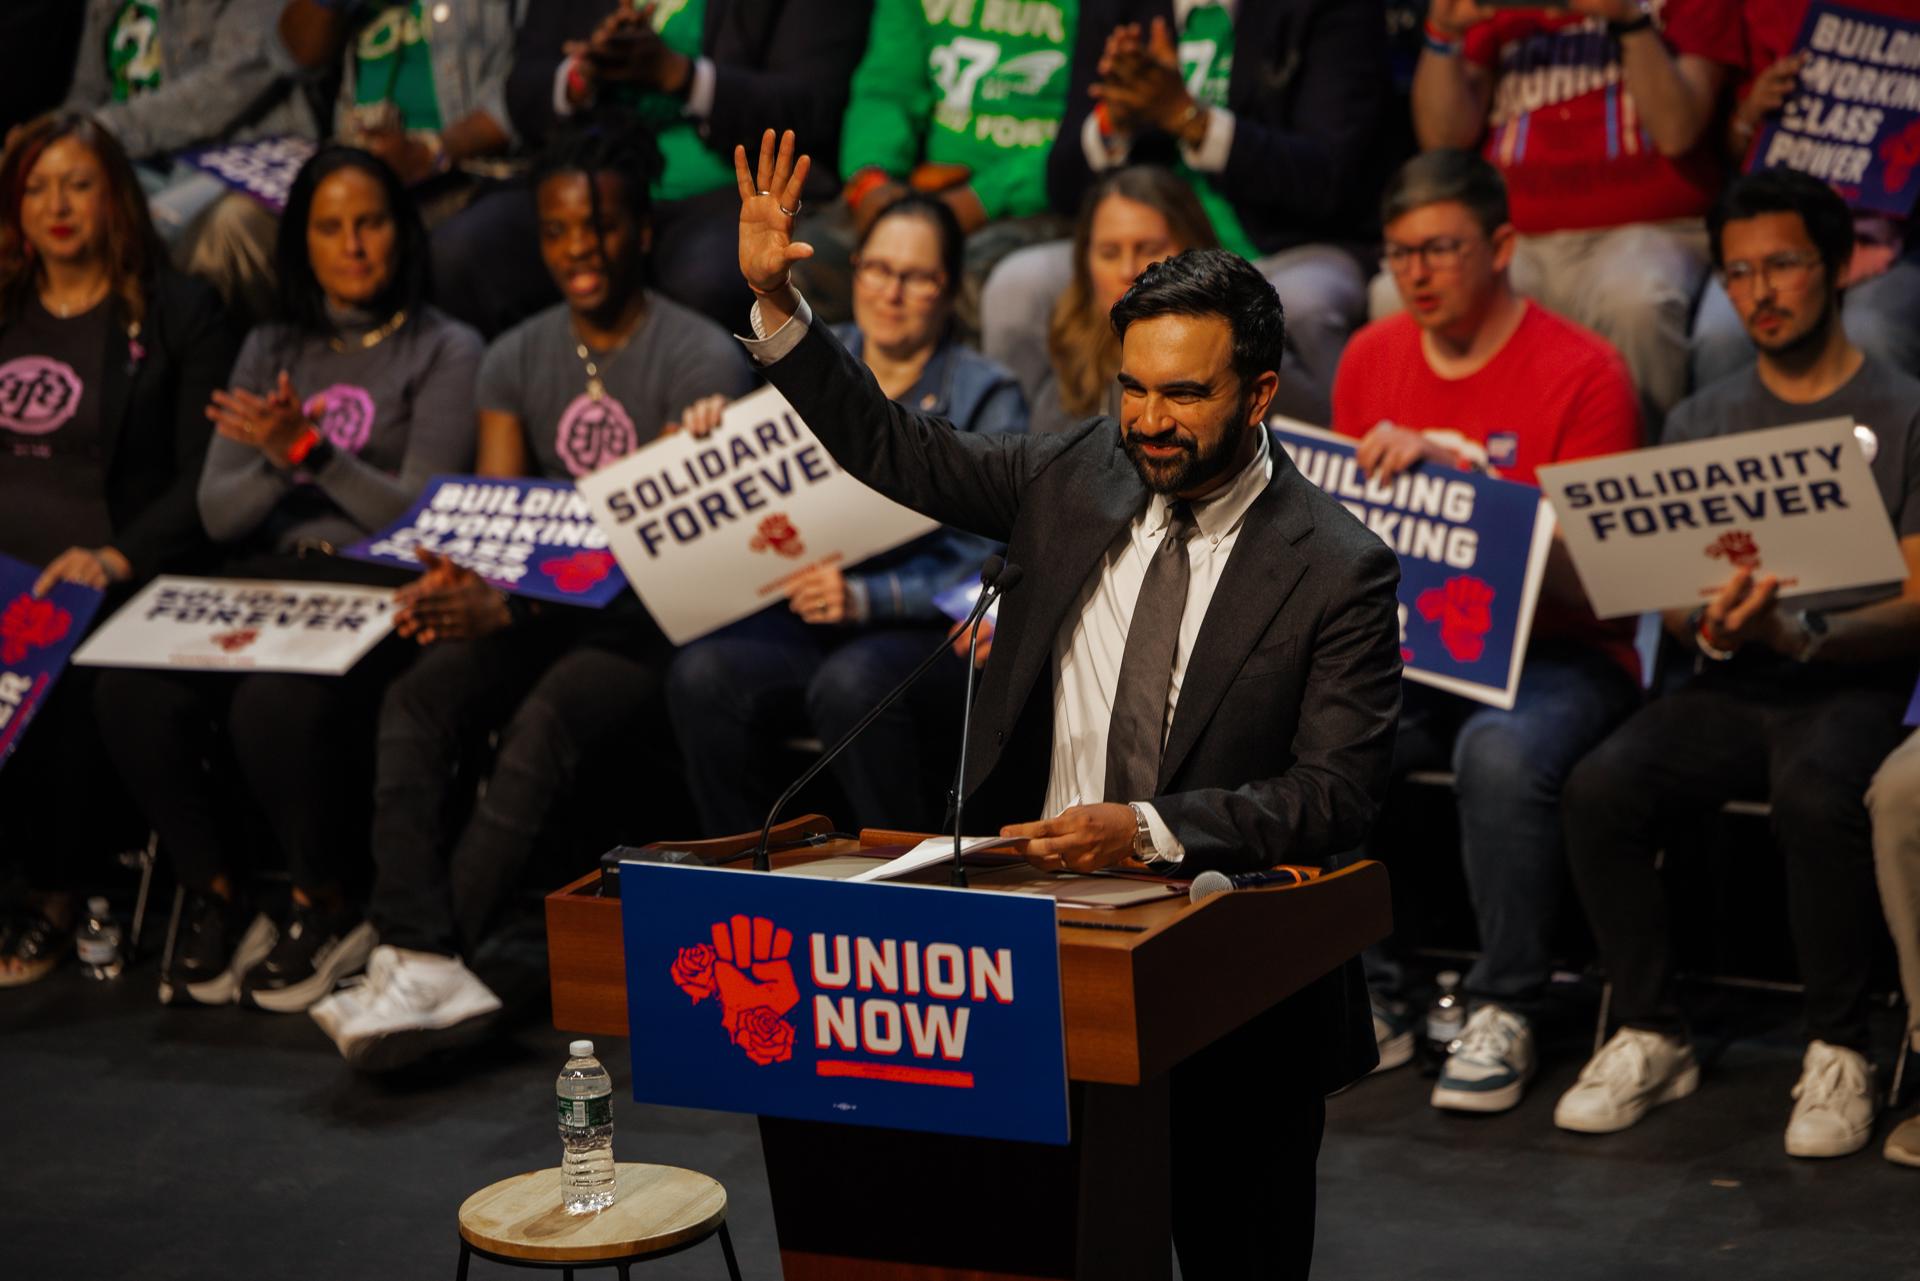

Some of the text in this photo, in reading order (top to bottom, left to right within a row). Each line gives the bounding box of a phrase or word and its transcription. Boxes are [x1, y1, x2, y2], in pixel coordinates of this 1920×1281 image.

[1801, 52, 1920, 112] WORKIN
[1782, 95, 1885, 144] CLASS
[1764, 130, 1873, 184] POWER
[607, 411, 802, 524] SOLIDARI
[1282, 442, 1476, 525] UILDING
[1564, 441, 1843, 509] SOLIDARITY
[431, 482, 594, 520] BUILDIN
[637, 445, 830, 558] FOREVE
[1589, 479, 1848, 541] FOREVER
[147, 604, 368, 631] FOREVER
[810, 932, 1014, 1004] UNION
[814, 995, 971, 1060] NOW
